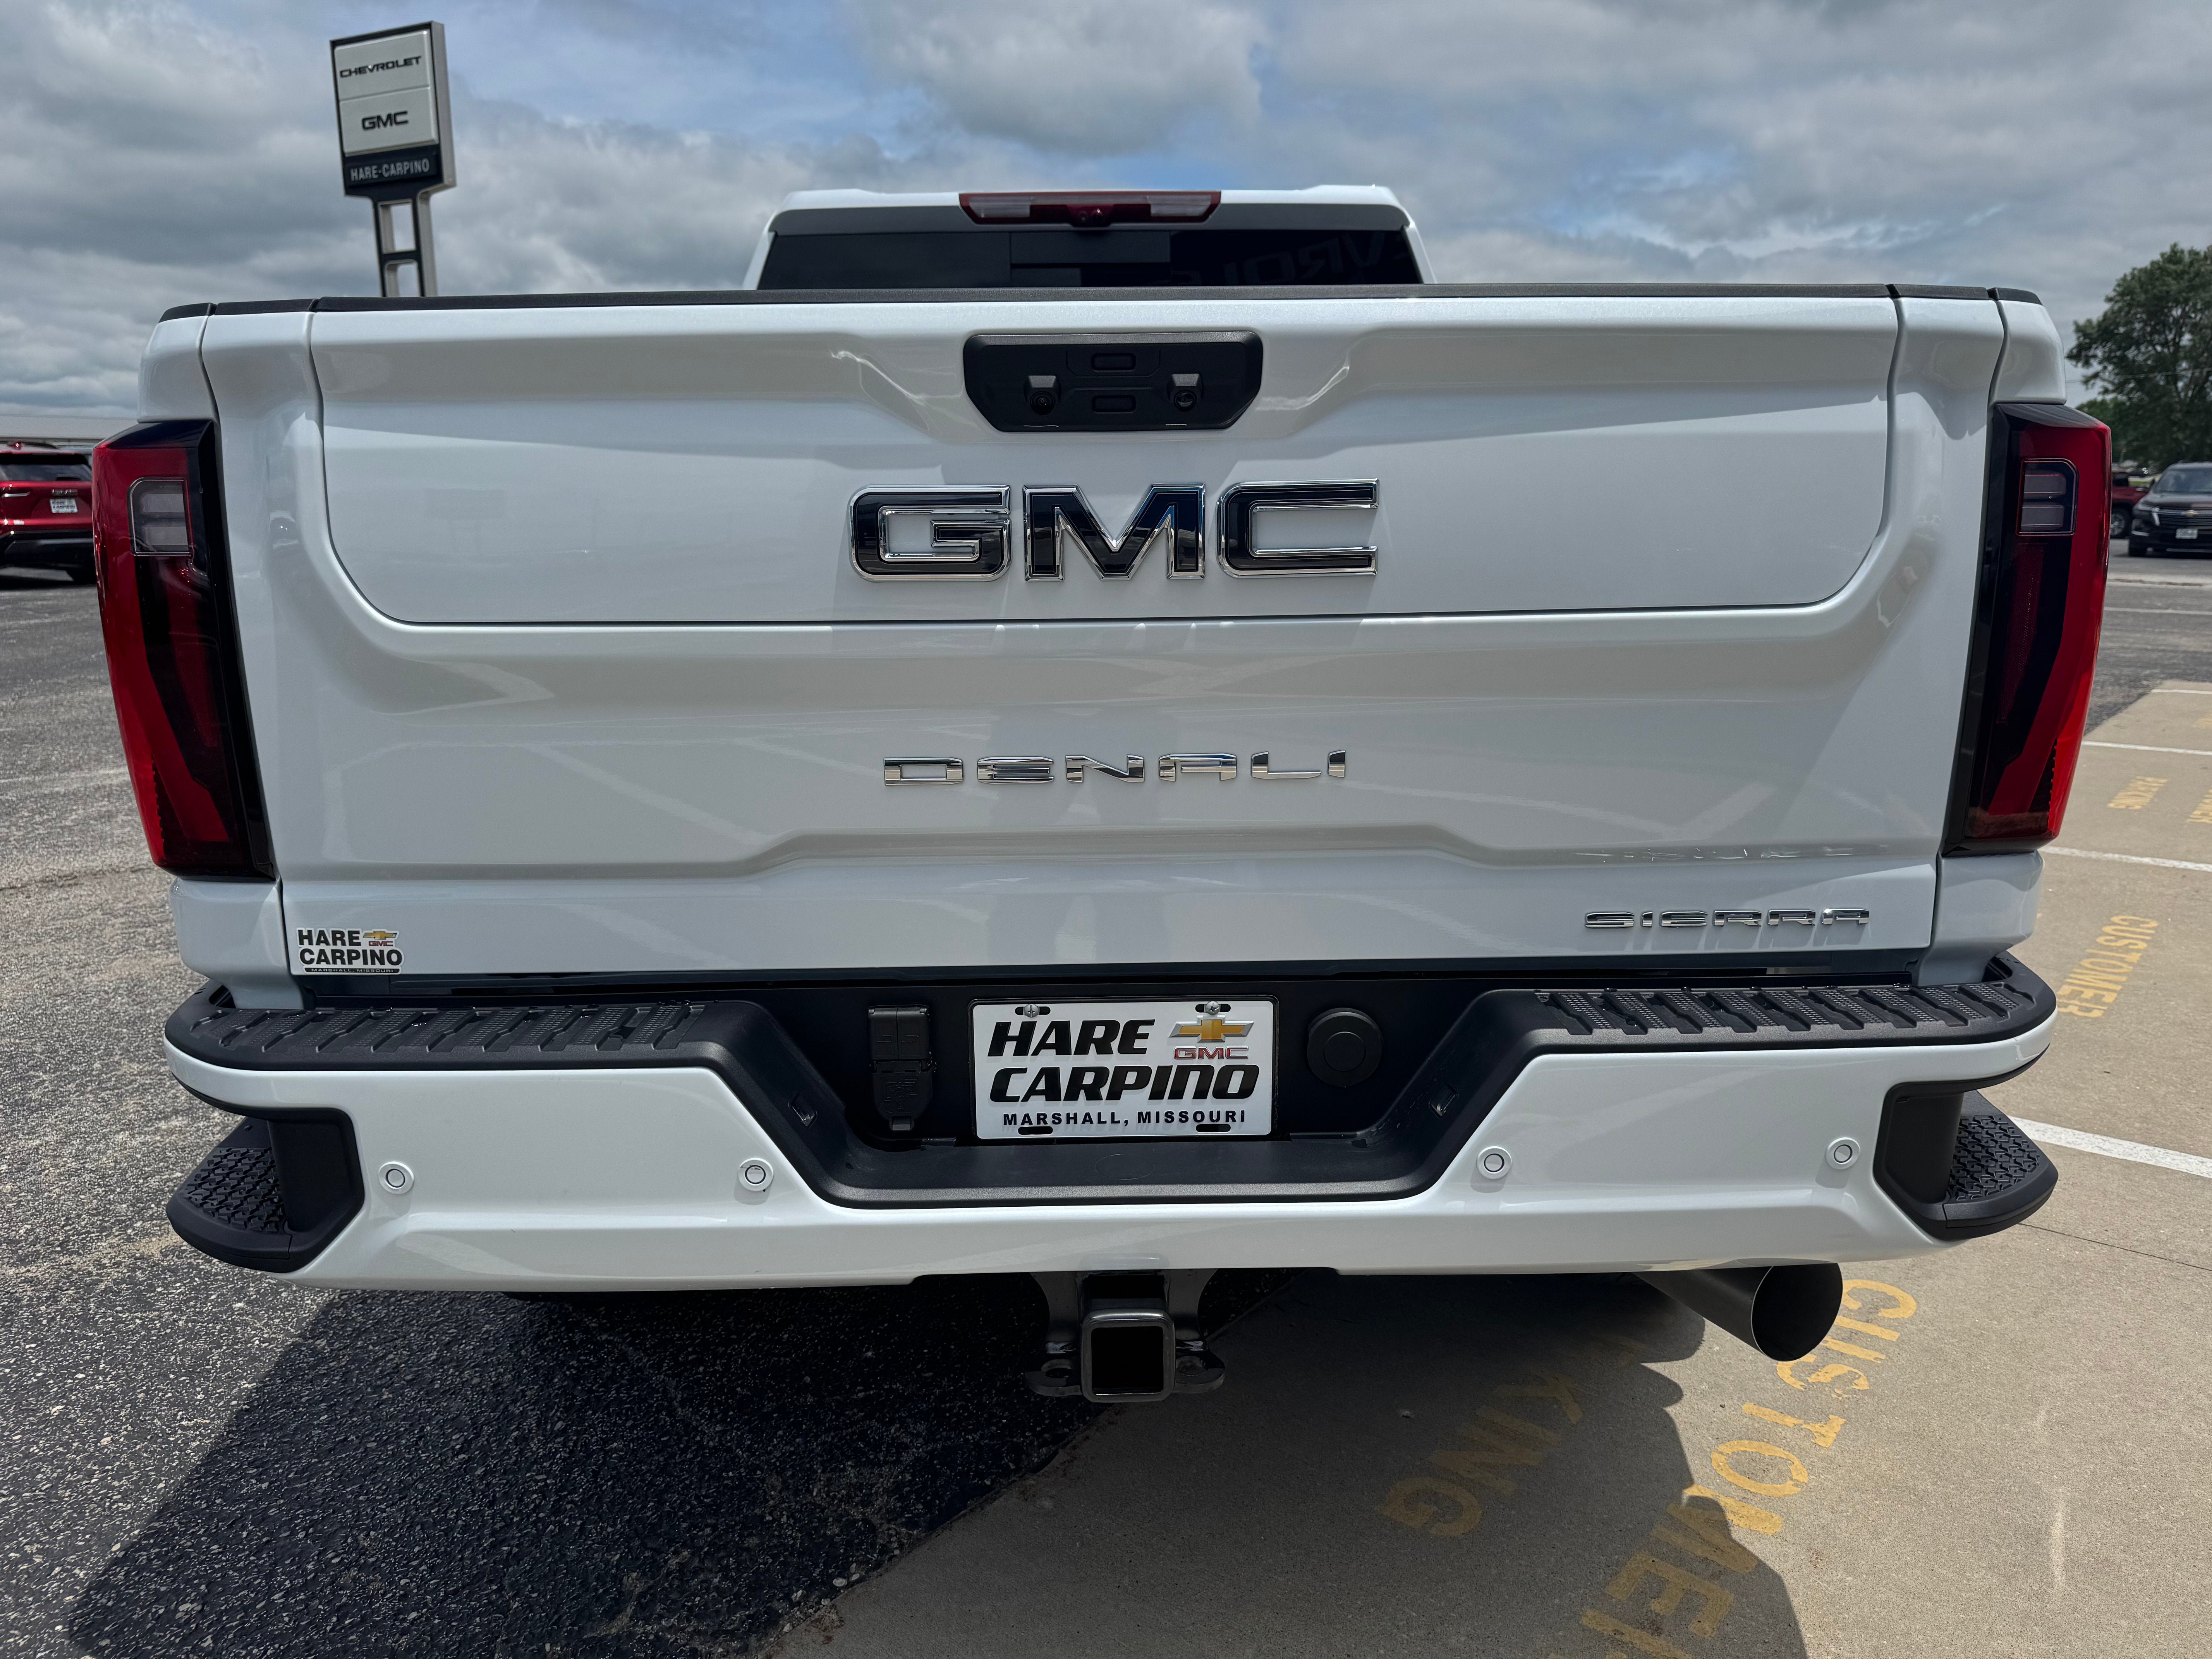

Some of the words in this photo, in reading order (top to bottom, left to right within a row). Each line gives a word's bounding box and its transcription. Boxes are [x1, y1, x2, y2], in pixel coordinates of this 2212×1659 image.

[339, 55, 422, 78] CHEVROLET
[361, 110, 409, 131] GMC
[350, 158, 430, 181] HARE-CARPINO
[850, 478, 1379, 582] GMC
[883, 750, 1346, 786] DENALI
[1585, 908, 1870, 927] SIERRA
[298, 929, 361, 946] HARE
[300, 948, 402, 966] CARPINO
[2056, 915, 2159, 1018] CUSTOMER
[987, 1019, 1155, 1057] HARE
[1173, 1046, 1249, 1060] GMC
[989, 1065, 1260, 1102] CARPINO
[1003, 1112, 1129, 1127] MARSHALL,
[1137, 1111, 1245, 1125] MISSOURI
